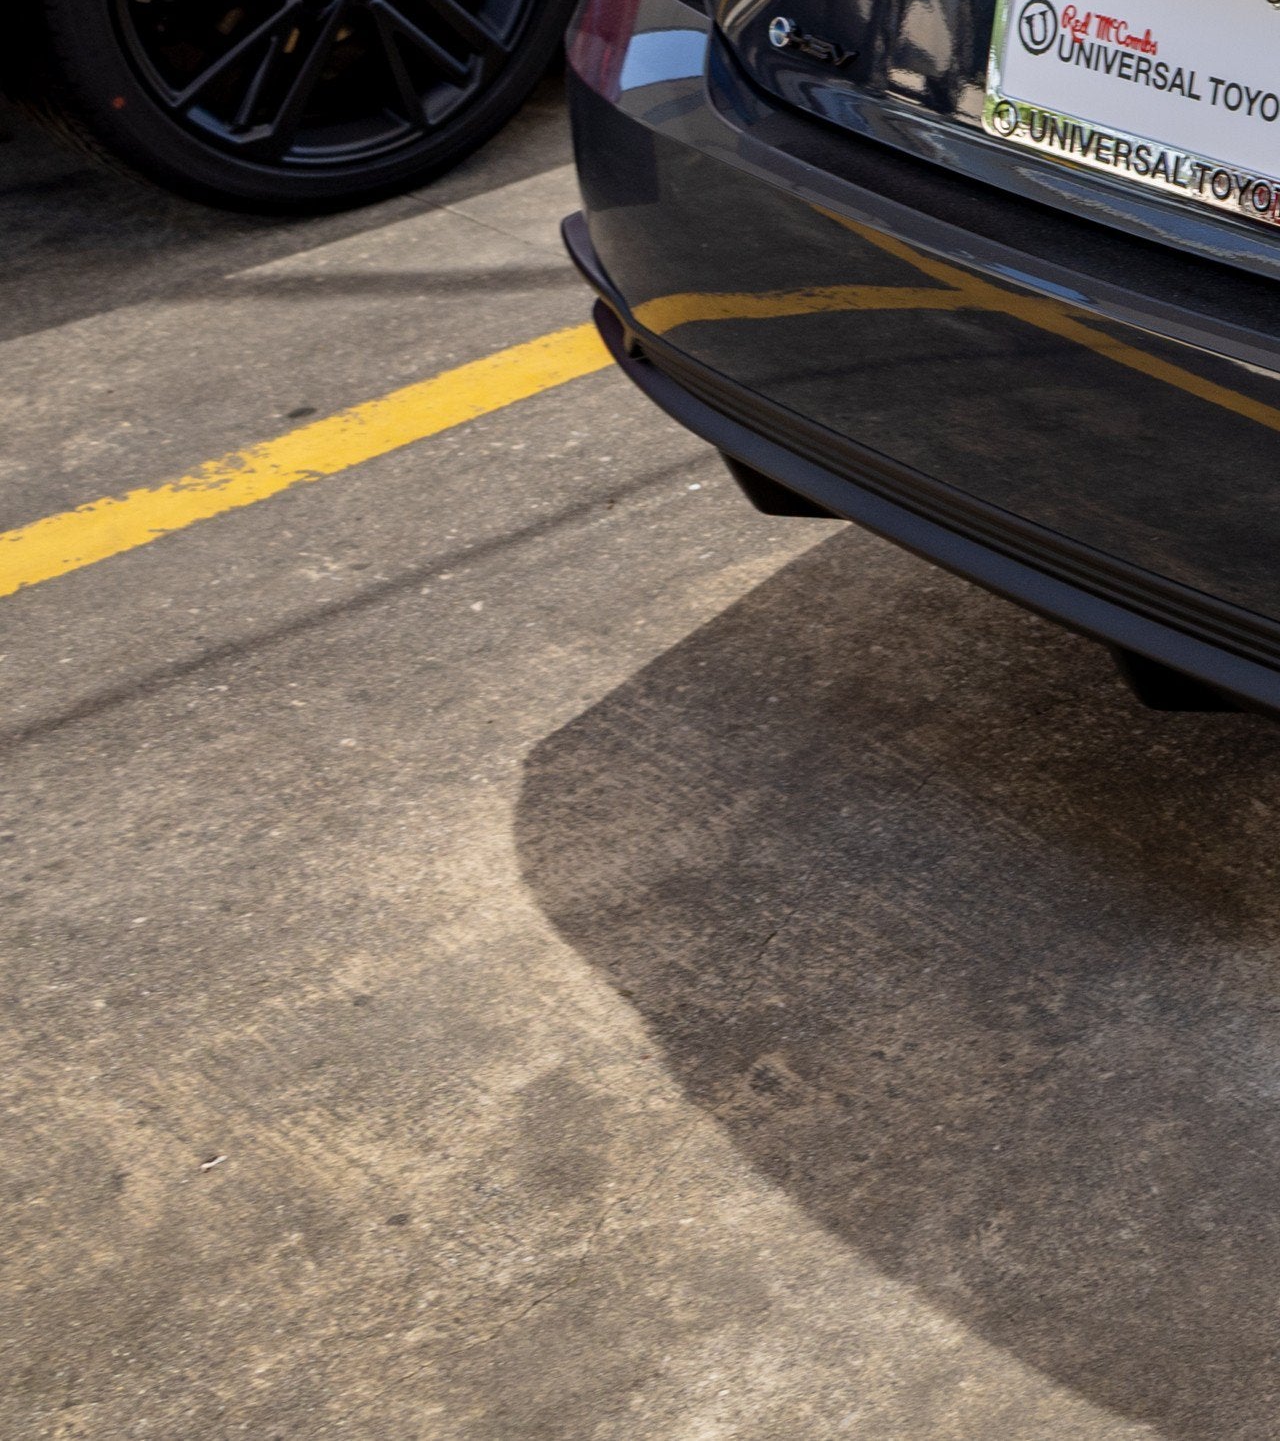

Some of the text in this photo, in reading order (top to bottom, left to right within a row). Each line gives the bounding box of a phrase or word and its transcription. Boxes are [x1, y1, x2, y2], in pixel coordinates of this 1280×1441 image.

[1061, 4, 1092, 44] Red
[1056, 33, 1201, 102] UNIVERSAL
[1029, 108, 1190, 189] UNIVERSAL
